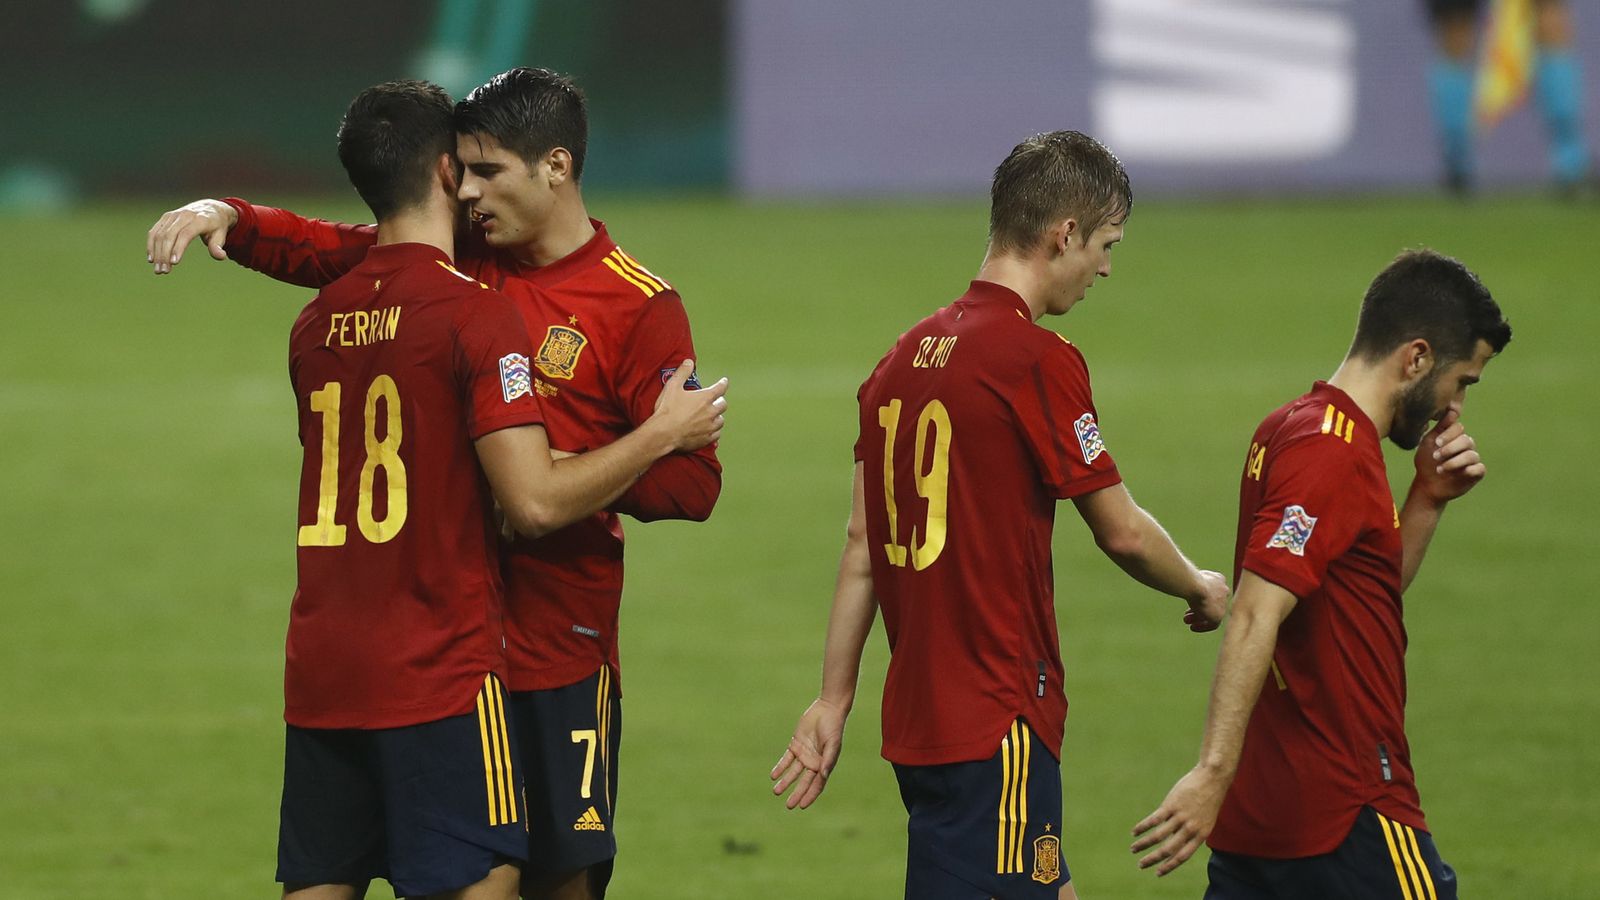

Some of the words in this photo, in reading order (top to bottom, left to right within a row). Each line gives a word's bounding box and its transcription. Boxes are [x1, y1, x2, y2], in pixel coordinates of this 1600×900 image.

[325, 306, 402, 347] FERRAN
[912, 335, 958, 368] OLMO
[298, 375, 408, 545] 18
[878, 398, 952, 571] 19
[571, 729, 597, 799] 7
[573, 820, 605, 832] adidas
